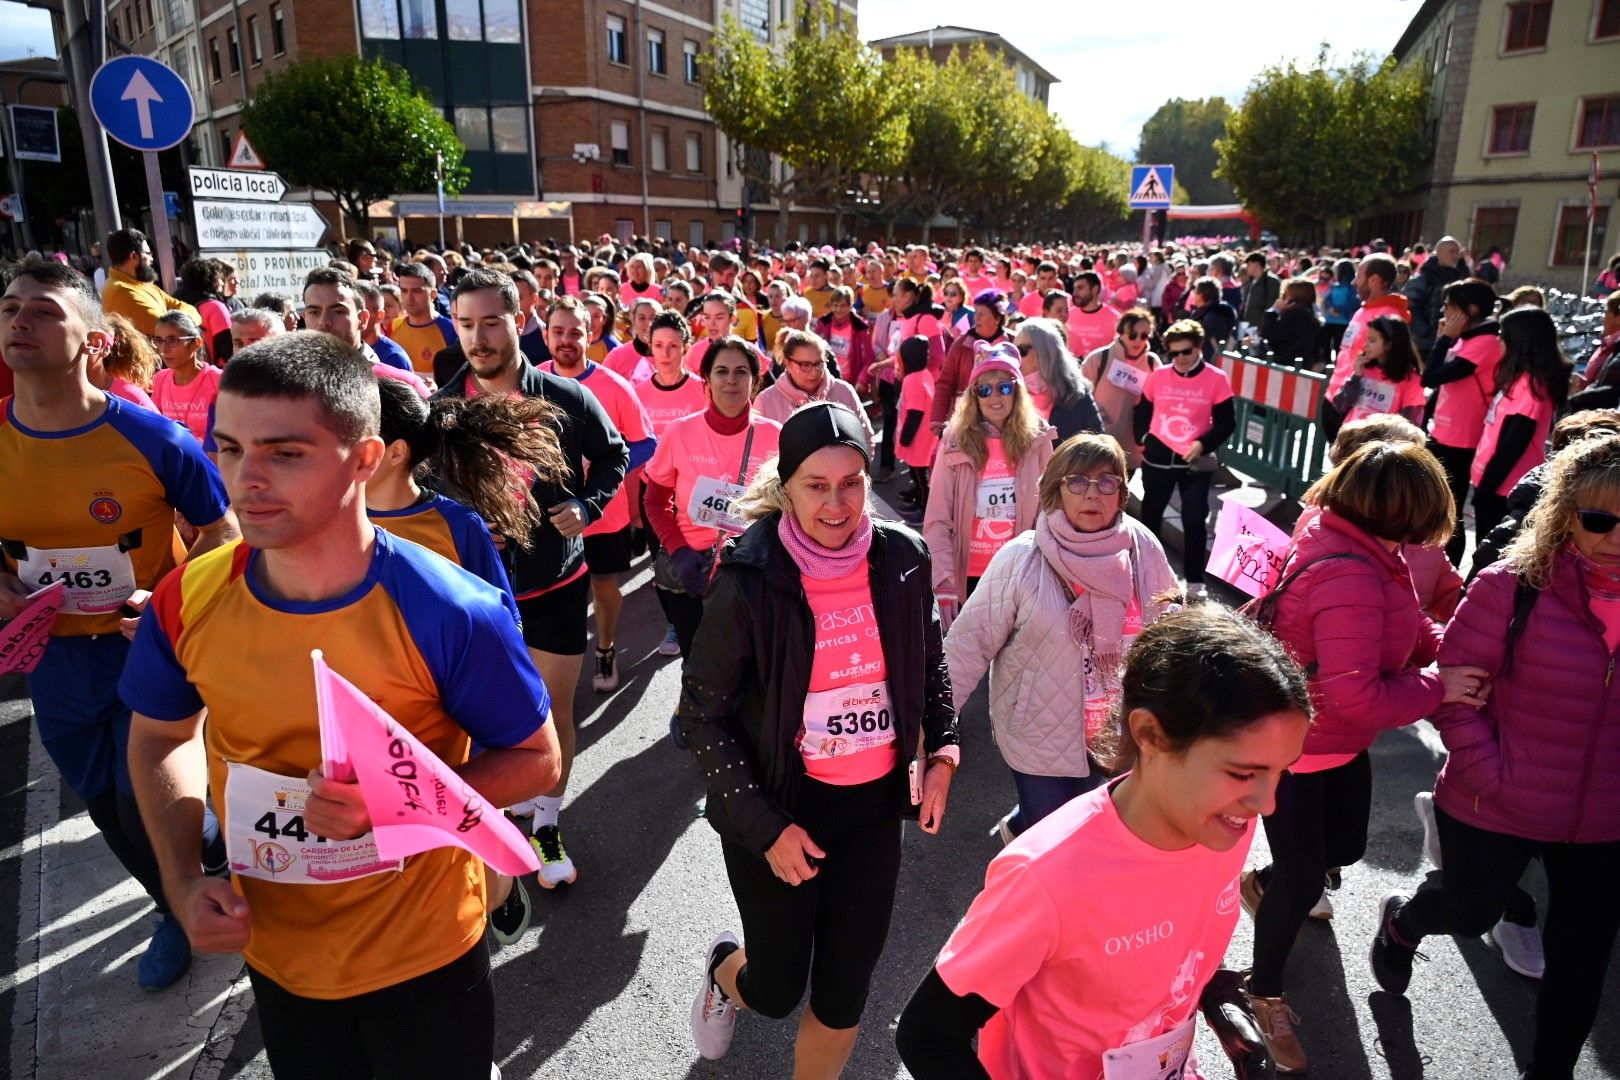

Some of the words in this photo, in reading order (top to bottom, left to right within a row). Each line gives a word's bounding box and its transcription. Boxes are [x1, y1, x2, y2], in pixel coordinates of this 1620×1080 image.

[193, 173, 242, 192] policia
[246, 176, 279, 194] local
[231, 257, 256, 271] GIO
[265, 256, 324, 270] PROVINCIAL
[264, 276, 286, 287] Ntra
[38, 570, 112, 588] 4463
[829, 660, 881, 680] SUZUKI
[827, 708, 890, 736] 5360
[301, 847, 339, 855] CARRERA
[1104, 920, 1174, 955] OYSHO
